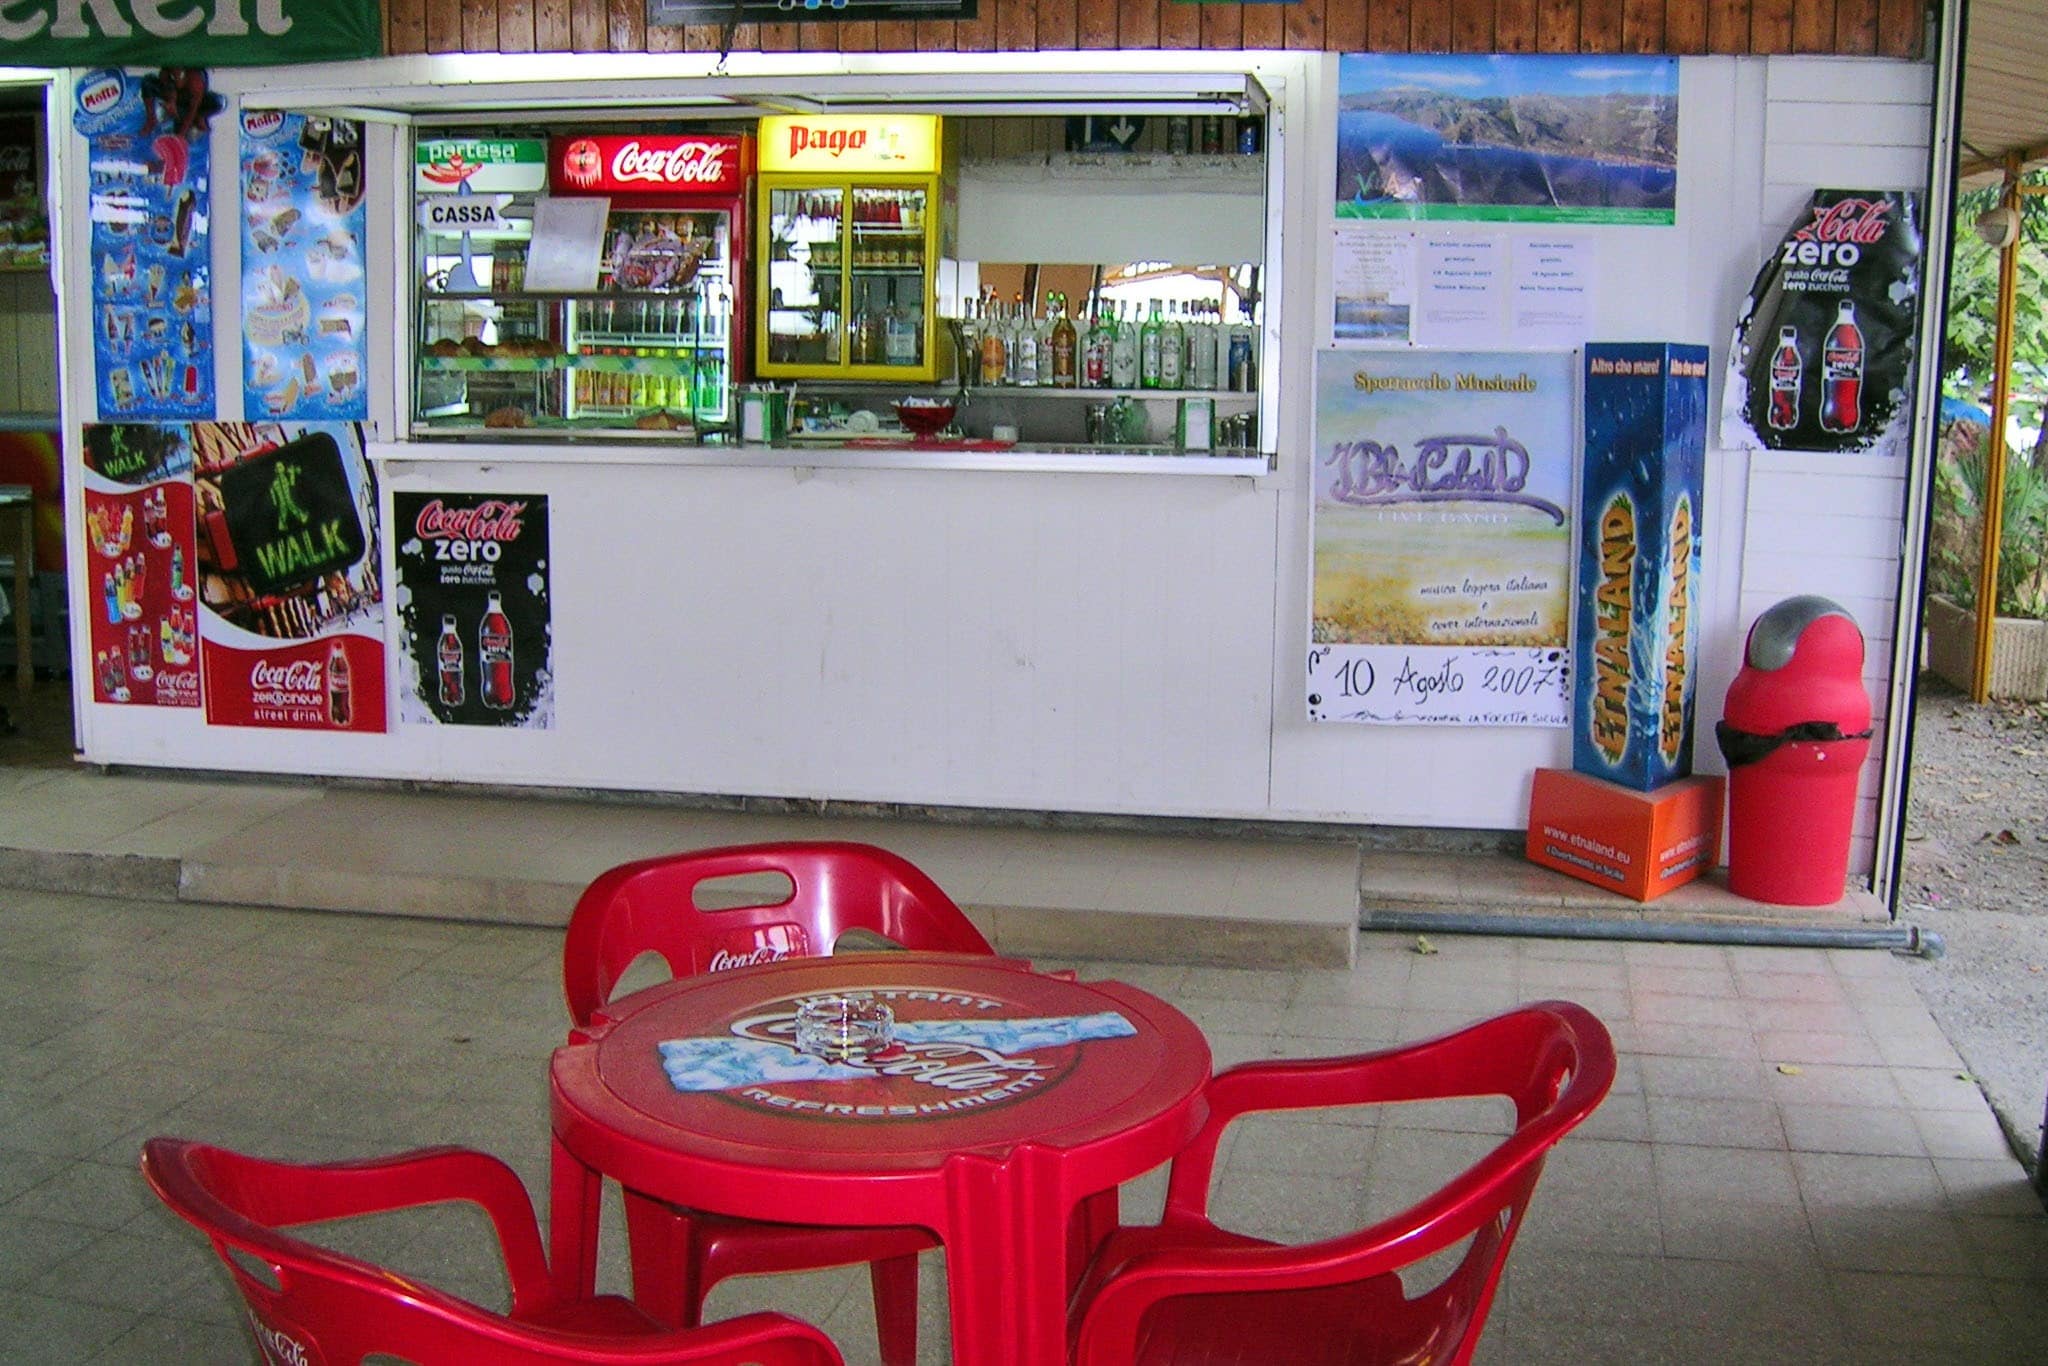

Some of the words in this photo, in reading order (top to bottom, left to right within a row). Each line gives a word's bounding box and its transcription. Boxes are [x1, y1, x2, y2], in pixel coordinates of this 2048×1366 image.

[789, 125, 866, 158] pago
[612, 142, 726, 183] Coca-Cola
[432, 206, 496, 223] CASSA
[1781, 241, 1859, 266] zero
[1782, 281, 1806, 290] zero
[1353, 371, 1451, 394] Spettacolo
[1455, 371, 1537, 393] Musicale
[104, 451, 147, 476] WALK
[415, 500, 527, 542] Coca-Cola
[255, 519, 348, 579] WALK
[435, 539, 502, 562] zero
[251, 659, 324, 691] Coca-Cola
[1334, 658, 1376, 697] 10
[1393, 655, 1465, 705] Agosto
[1480, 665, 1559, 695] 2007
[254, 708, 289, 721] street
[292, 708, 324, 722] drink
[1543, 825, 1631, 865] www.etnaland.eu
[729, 1012, 1055, 1090] CCola
[742, 1070, 1047, 1117] REFRESHMENT
